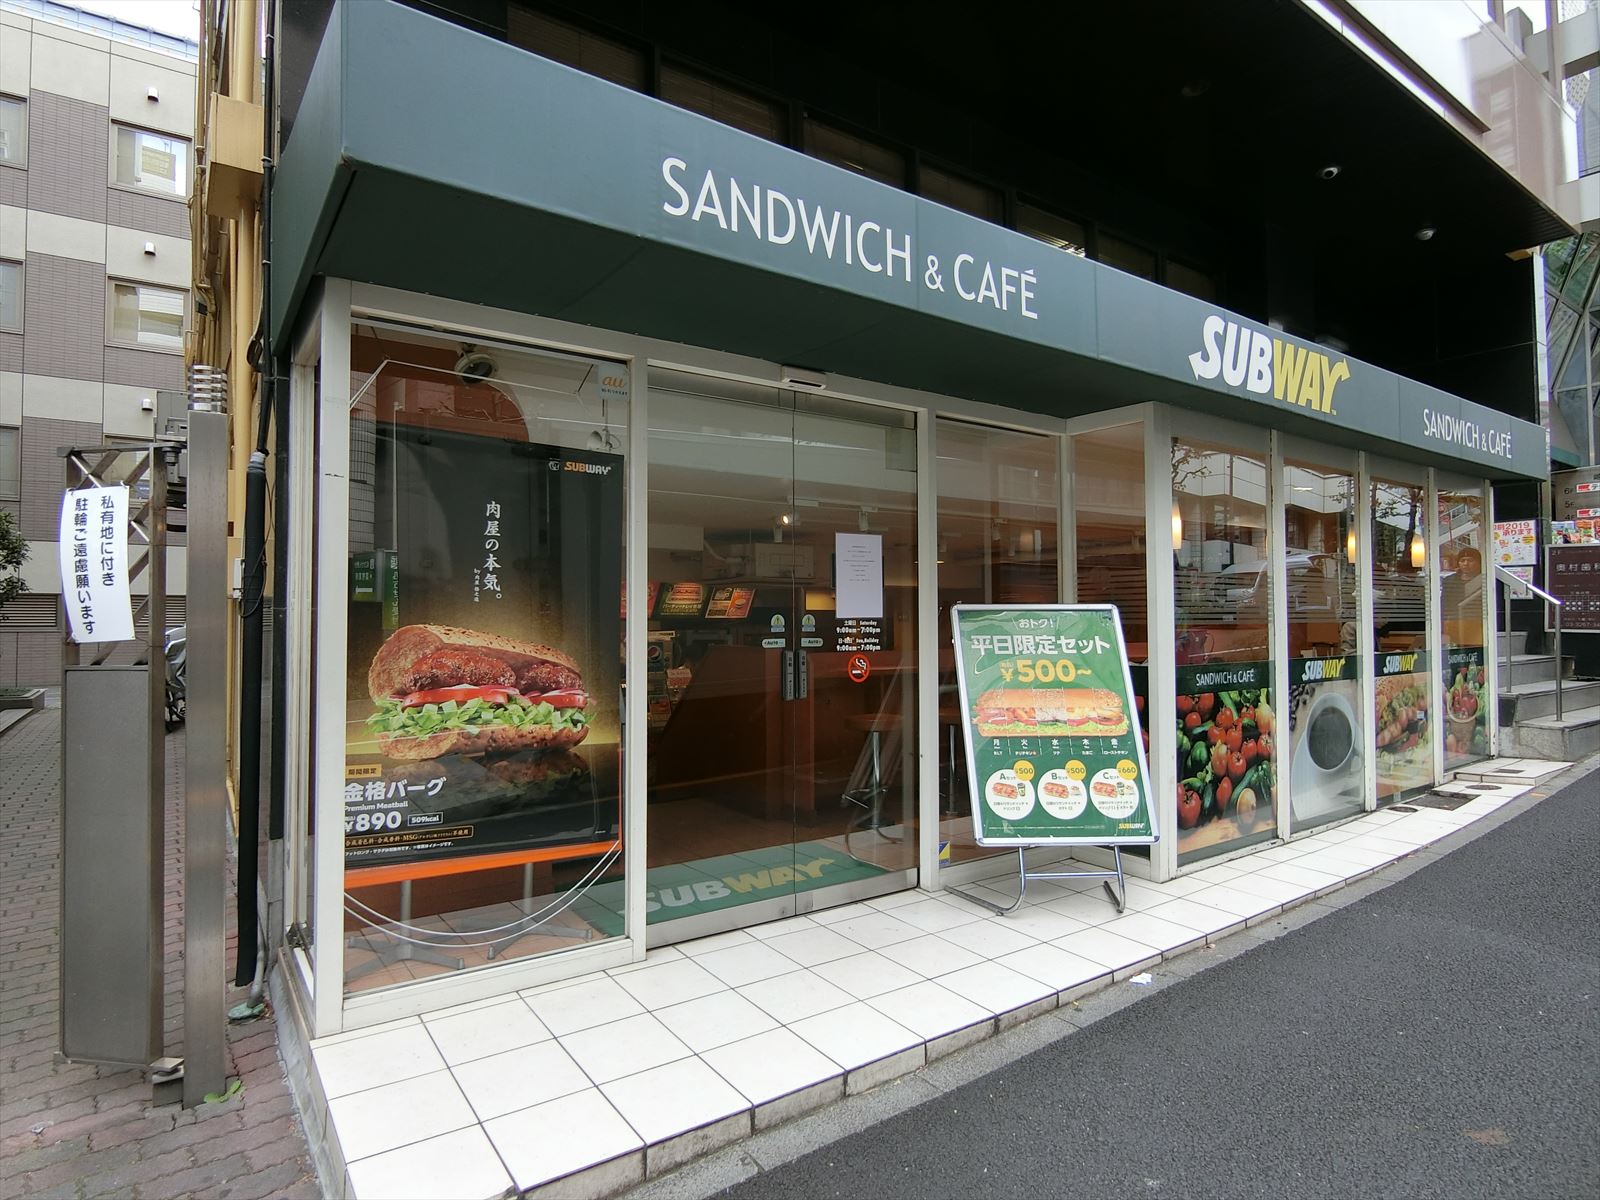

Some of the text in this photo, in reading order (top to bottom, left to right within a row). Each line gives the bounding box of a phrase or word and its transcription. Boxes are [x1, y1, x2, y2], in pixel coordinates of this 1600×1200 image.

[662, 157, 1038, 320] SANDWICH & CAFÉ
[1188, 315, 1351, 415] SUBWAY
[602, 376, 625, 389] au
[1423, 408, 1512, 459] SANDWICH & CAFÉ
[564, 461, 612, 475] SUBWAY
[100, 495, 115, 587] 私有地に付き
[483, 501, 502, 599] 肉屋の本気。
[74, 498, 96, 634] 駐輪ご遠慮願います
[971, 635, 1111, 656] 平日限定セット
[1302, 655, 1346, 681] SUBWAY
[1383, 652, 1418, 674] SUBWAY
[1447, 654, 1467, 665] SANDWICH
[1196, 667, 1256, 686] SANDWICH & CAFÉ
[993, 738, 1001, 746] 月
[1021, 738, 1028, 746] 火
[1052, 738, 1060, 746] 水
[1082, 738, 1090, 746] 木
[344, 776, 447, 802] 金格バーグ
[376, 800, 409, 809] Meatball
[411, 815, 440, 824] 509kcal
